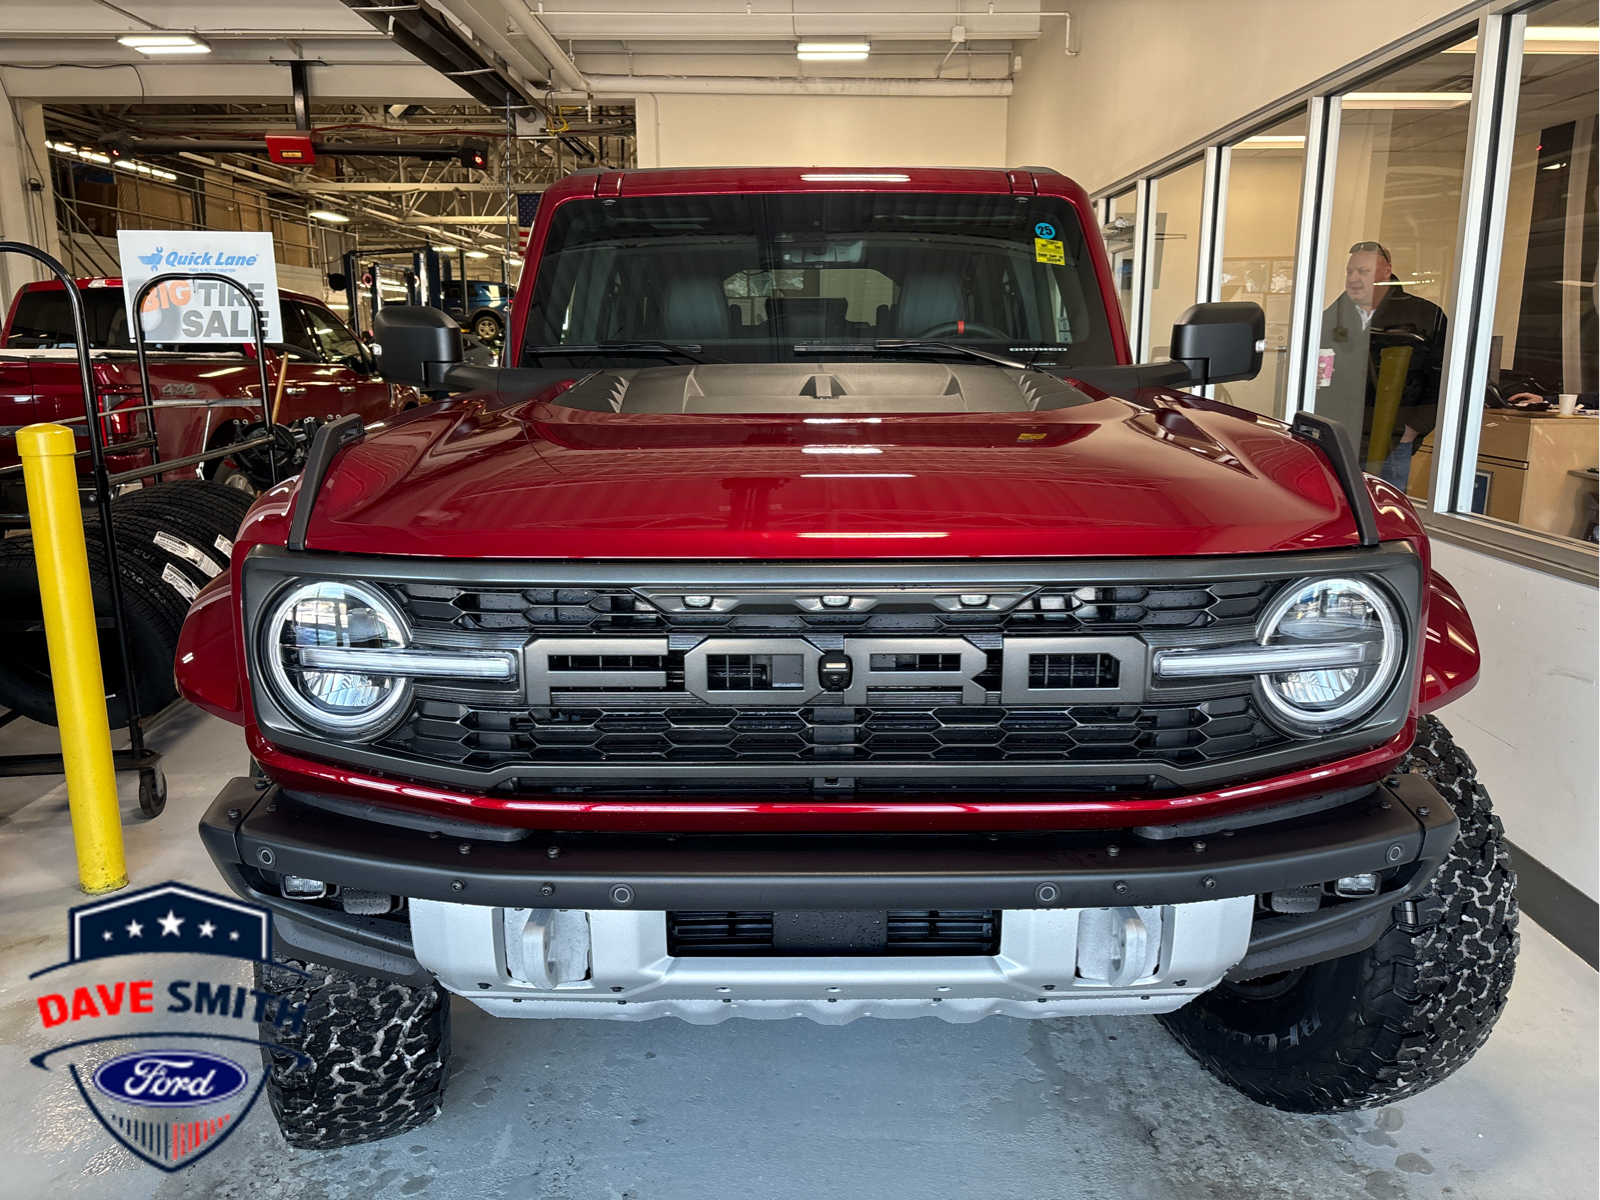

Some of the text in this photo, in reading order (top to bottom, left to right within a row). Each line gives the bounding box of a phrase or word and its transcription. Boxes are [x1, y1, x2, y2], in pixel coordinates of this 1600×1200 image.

[1038, 226, 1053, 236] 25
[166, 251, 257, 267] Quick Lane
[197, 283, 264, 307] TIRE
[182, 310, 269, 338] SALE
[523, 636, 1149, 706] FORD
